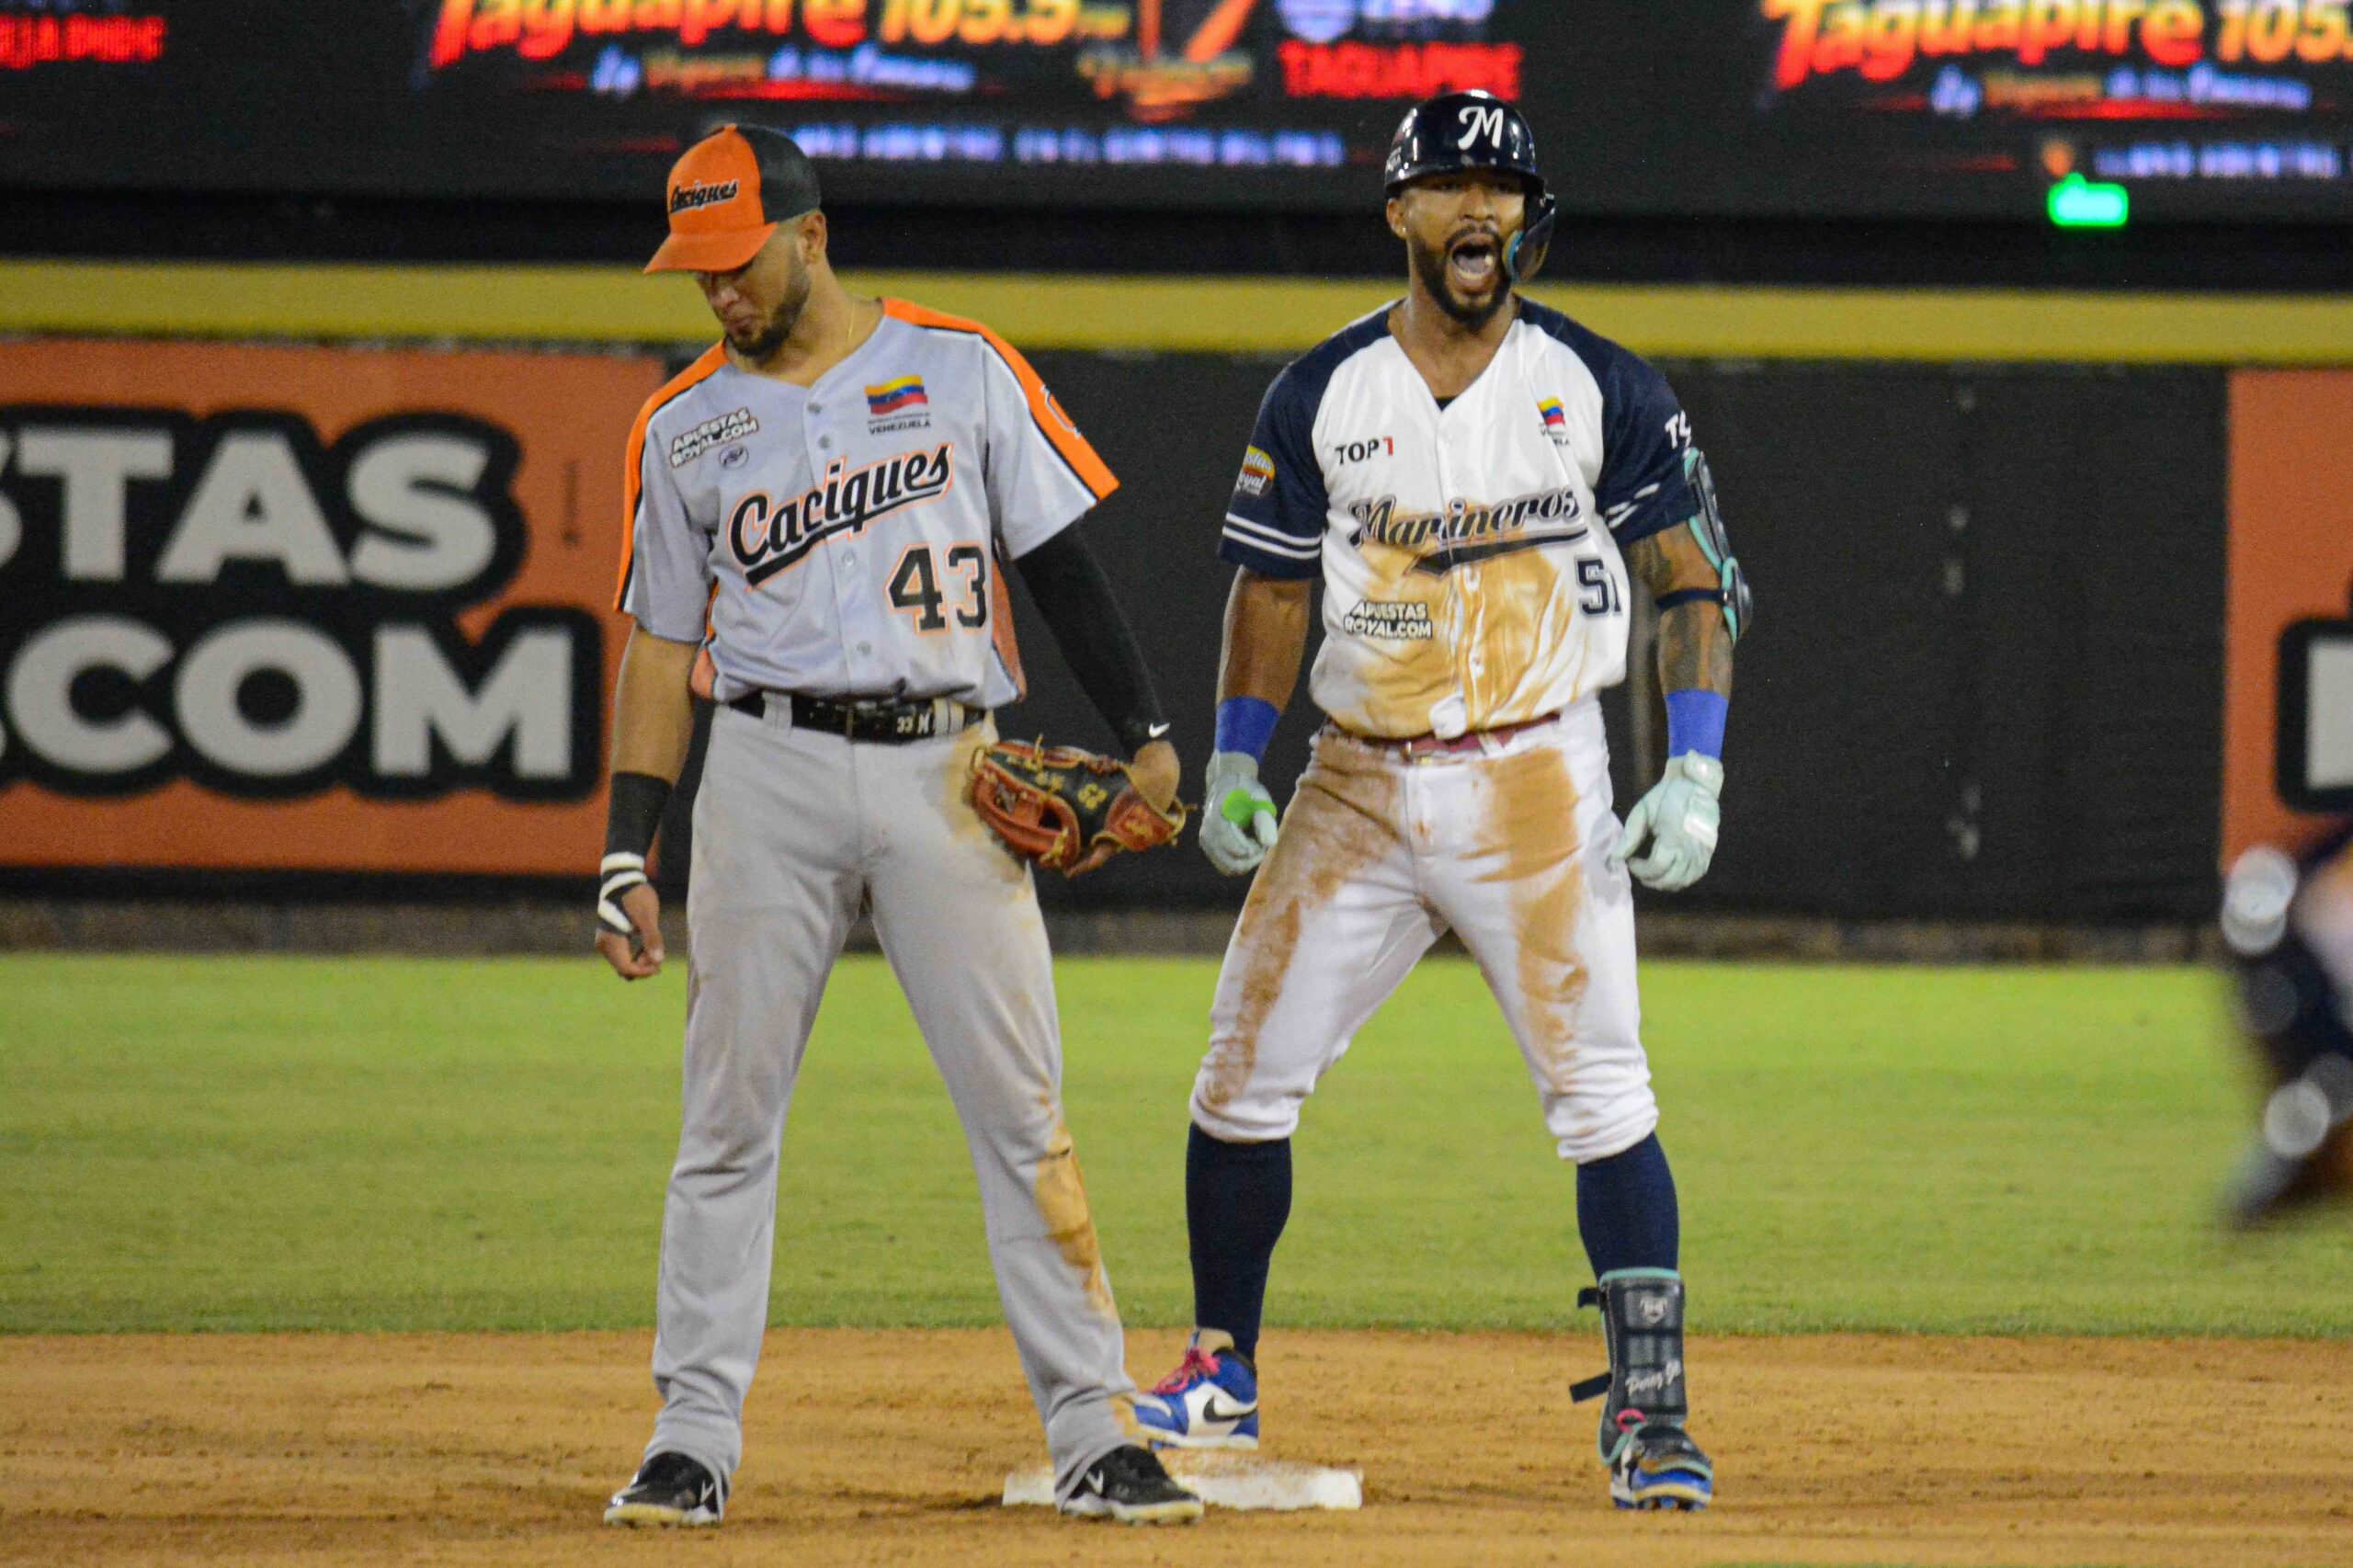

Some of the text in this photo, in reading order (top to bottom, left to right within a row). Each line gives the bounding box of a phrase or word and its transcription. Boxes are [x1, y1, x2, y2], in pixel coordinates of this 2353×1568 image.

[1757, 0, 2206, 89] Taguapire
[1457, 105, 1504, 151] M
[670, 416, 759, 467] ROYAL.COM
[672, 406, 751, 455] APUESTAS
[869, 417, 931, 436] VENEZUELA
[1335, 435, 1394, 465] TOP 1
[0, 425, 497, 593] TAS
[725, 442, 953, 574] Caciques
[1347, 485, 1583, 549] Marineros
[884, 542, 989, 635] 43
[1350, 599, 1427, 621] APUESTAS
[1574, 555, 1621, 618] 51
[1344, 614, 1433, 640] ROYAL.COM
[0, 614, 575, 781] COM
